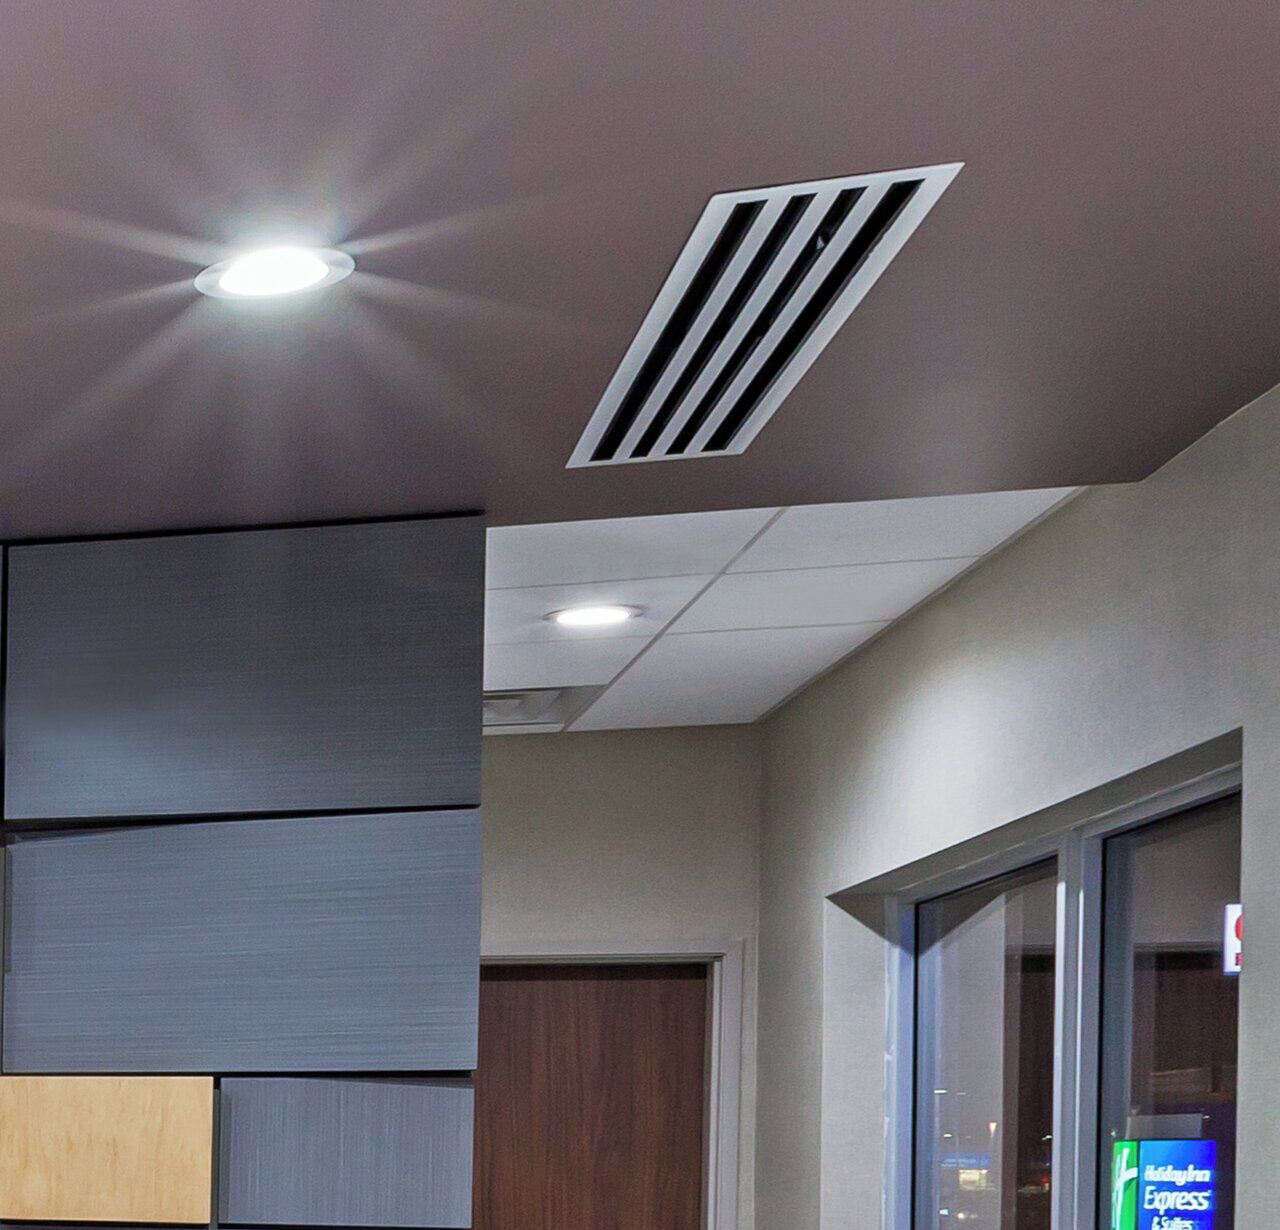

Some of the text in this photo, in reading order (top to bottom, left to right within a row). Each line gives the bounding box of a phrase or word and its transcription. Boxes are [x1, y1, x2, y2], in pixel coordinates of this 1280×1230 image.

[1144, 1164, 1211, 1186] Holiday Inn
[1143, 1185, 1211, 1215] Express
[1151, 1216, 1161, 1230] &
